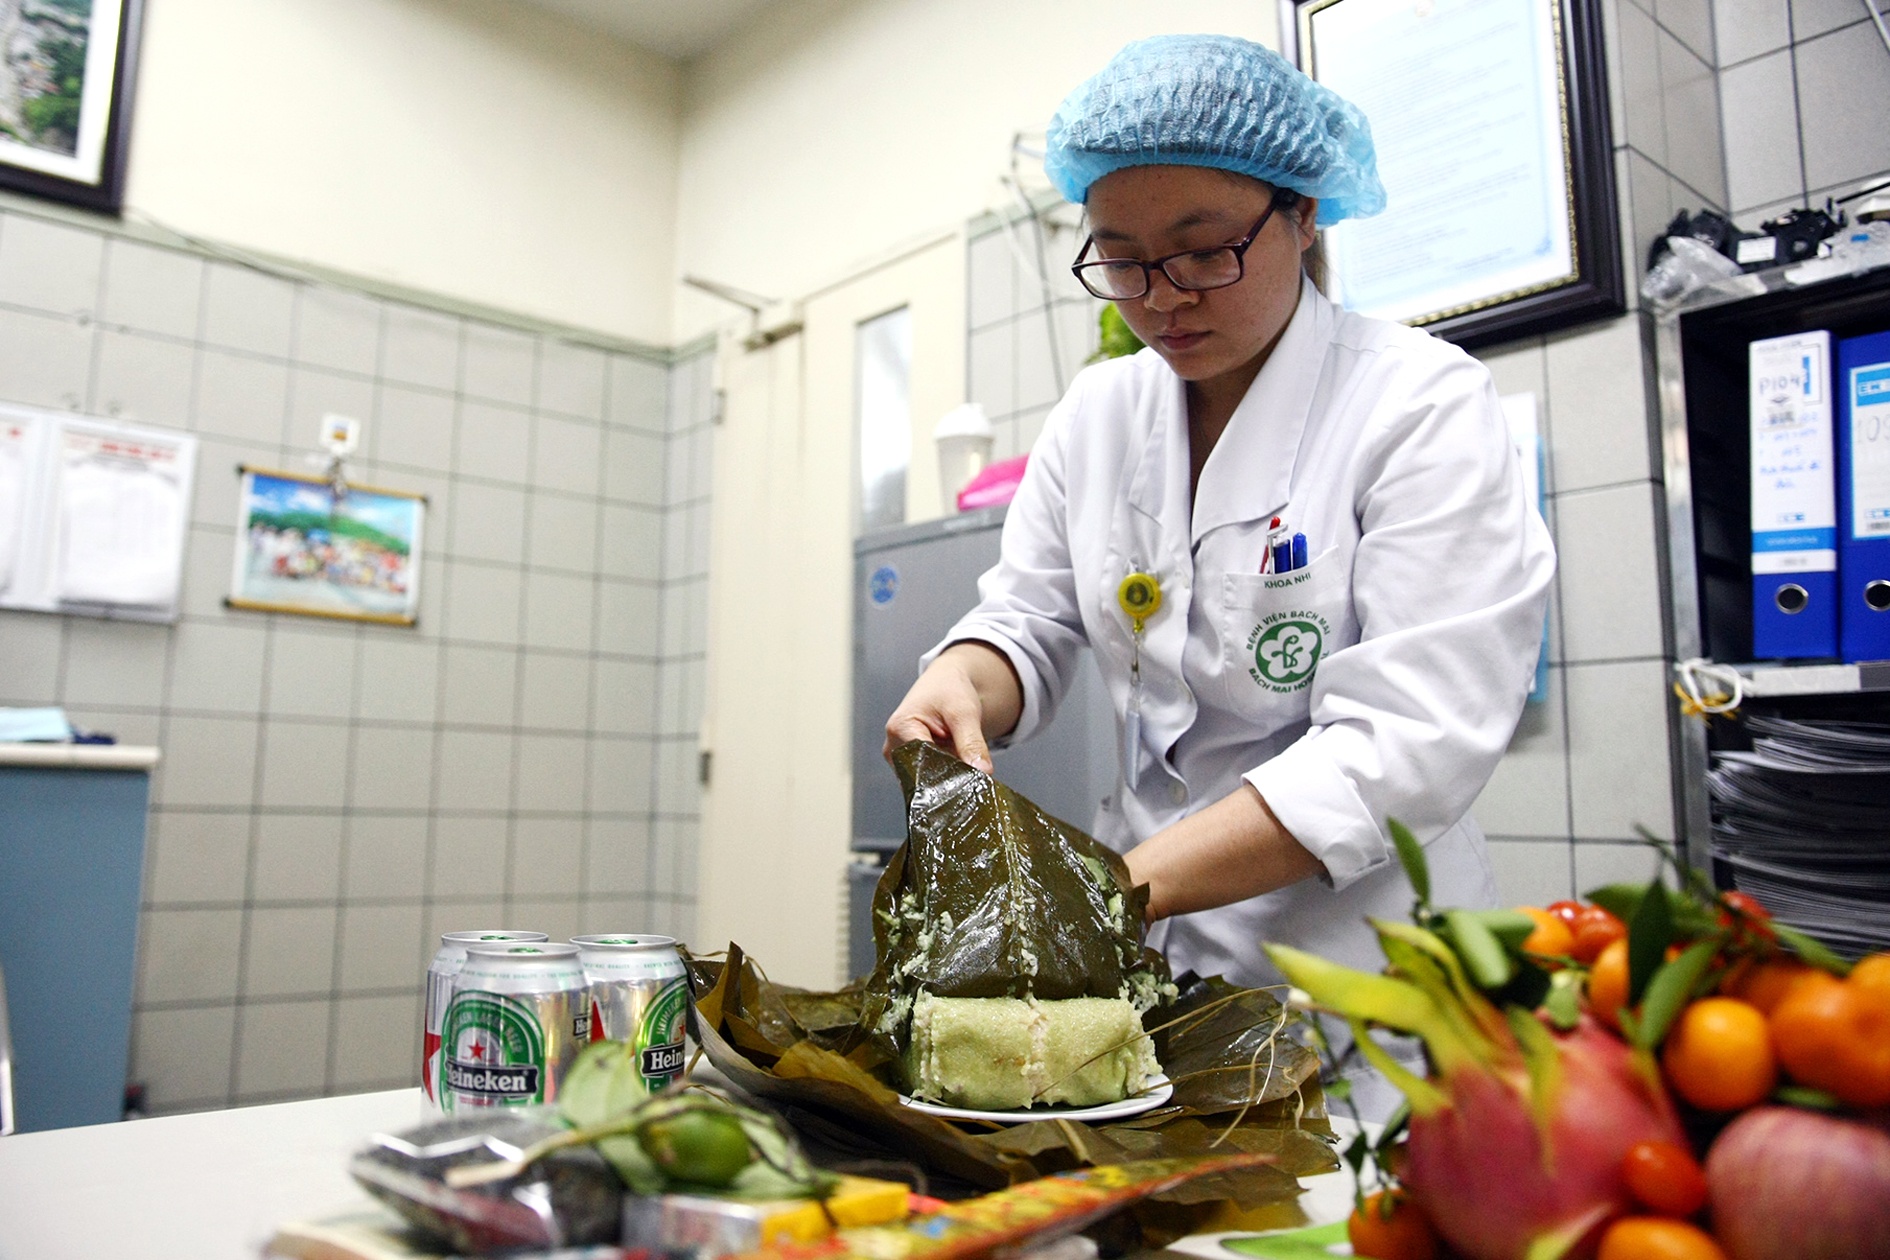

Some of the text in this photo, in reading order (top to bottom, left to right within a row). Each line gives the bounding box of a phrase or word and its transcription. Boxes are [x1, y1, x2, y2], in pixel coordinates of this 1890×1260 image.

[1264, 572, 1312, 589] KHOA NHI
[1318, 617, 1331, 635] MAI
[1271, 684, 1292, 693] MAI
[650, 1049, 685, 1070] Hein
